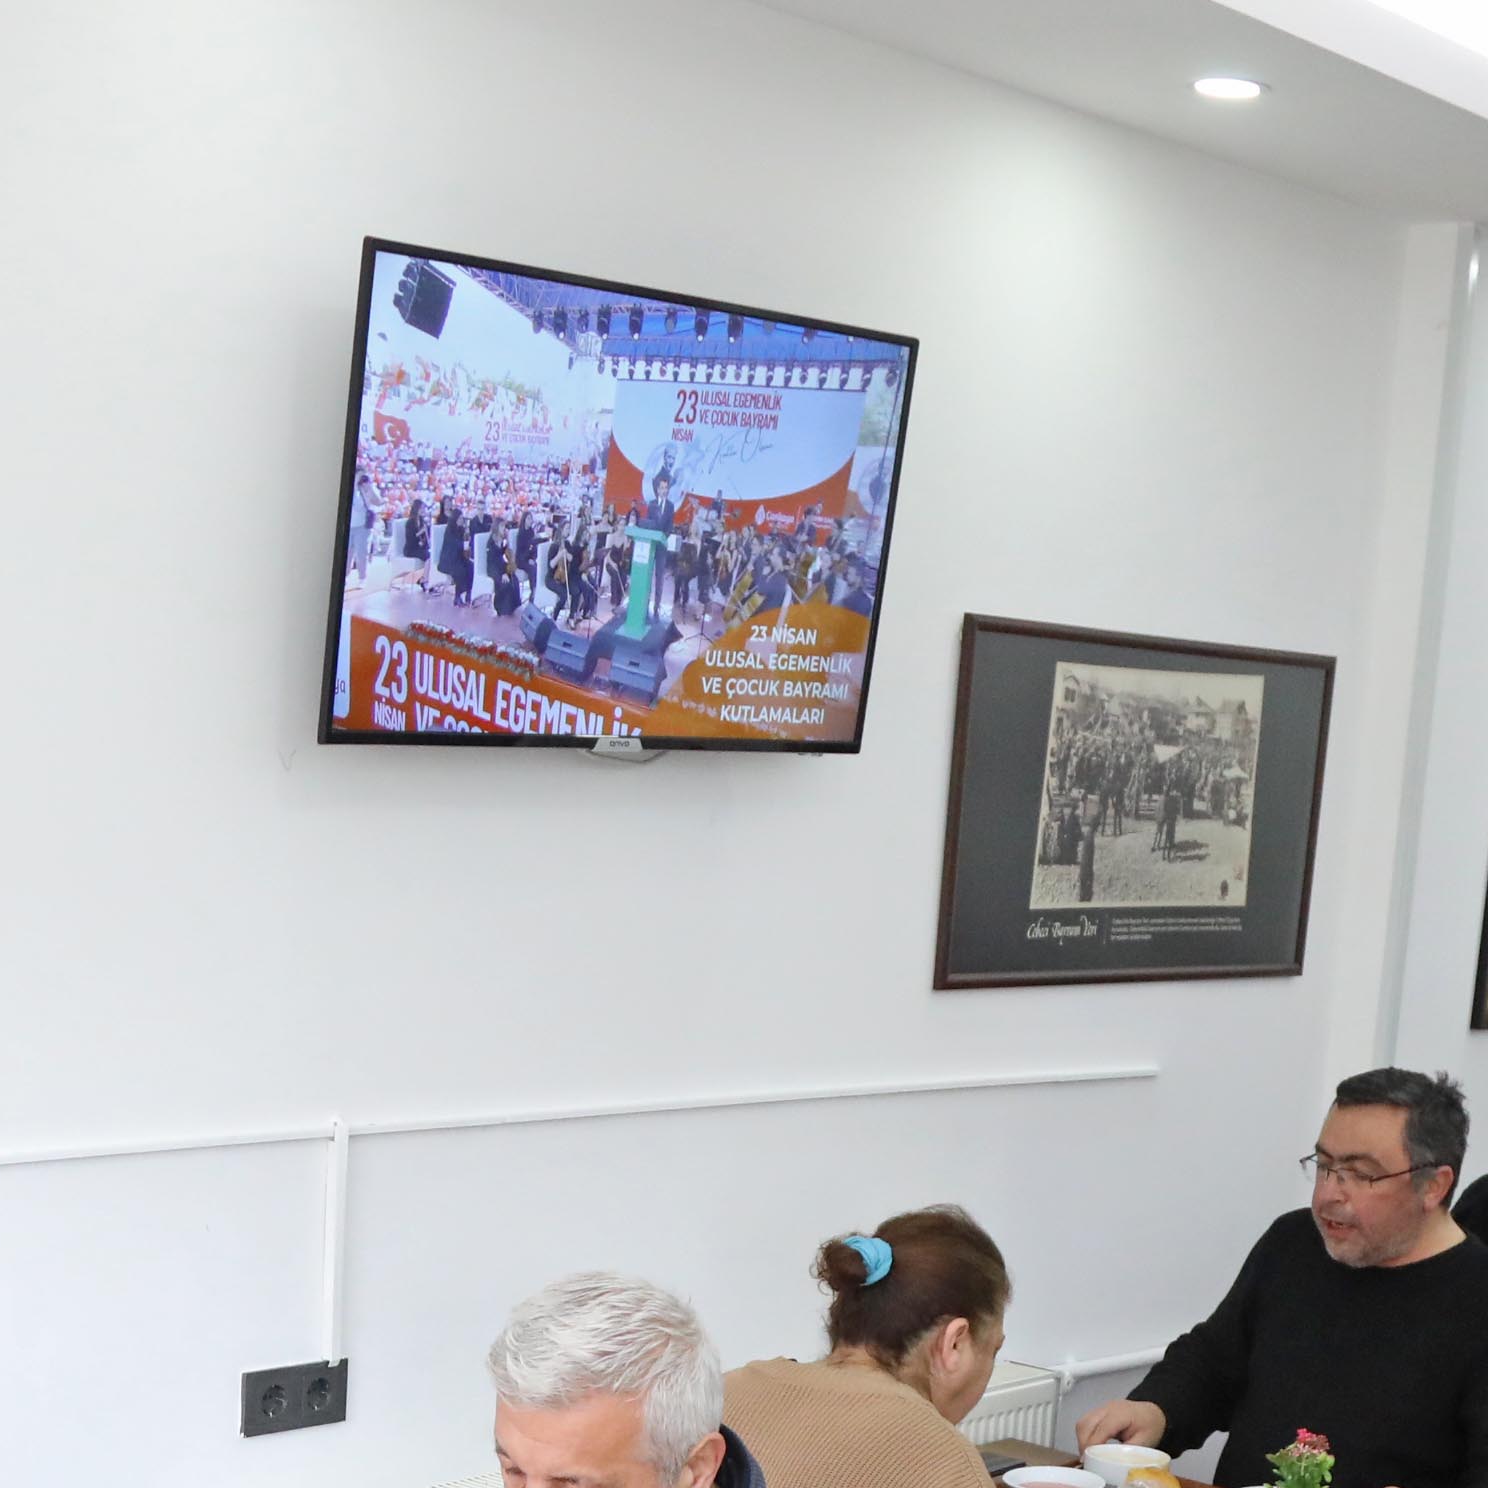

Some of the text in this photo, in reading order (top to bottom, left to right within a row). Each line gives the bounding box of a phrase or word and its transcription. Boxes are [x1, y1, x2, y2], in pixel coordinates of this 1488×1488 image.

[673, 389, 698, 424] 23
[700, 389, 782, 411] ULUSAL EGEMENLİK
[699, 409, 779, 432] VE ÇOCUK BAYRAMI
[750, 623, 818, 645] 23 NİSAN
[374, 634, 408, 705] 23
[705, 651, 853, 674] ULUSAL EGEMENLİK
[415, 650, 643, 737] ULUSAL EGEMEN
[701, 676, 849, 700] VE ÇOCUK BAYRAMI
[373, 698, 406, 731] NİSAN
[719, 704, 825, 725] KUTLAMALARI
